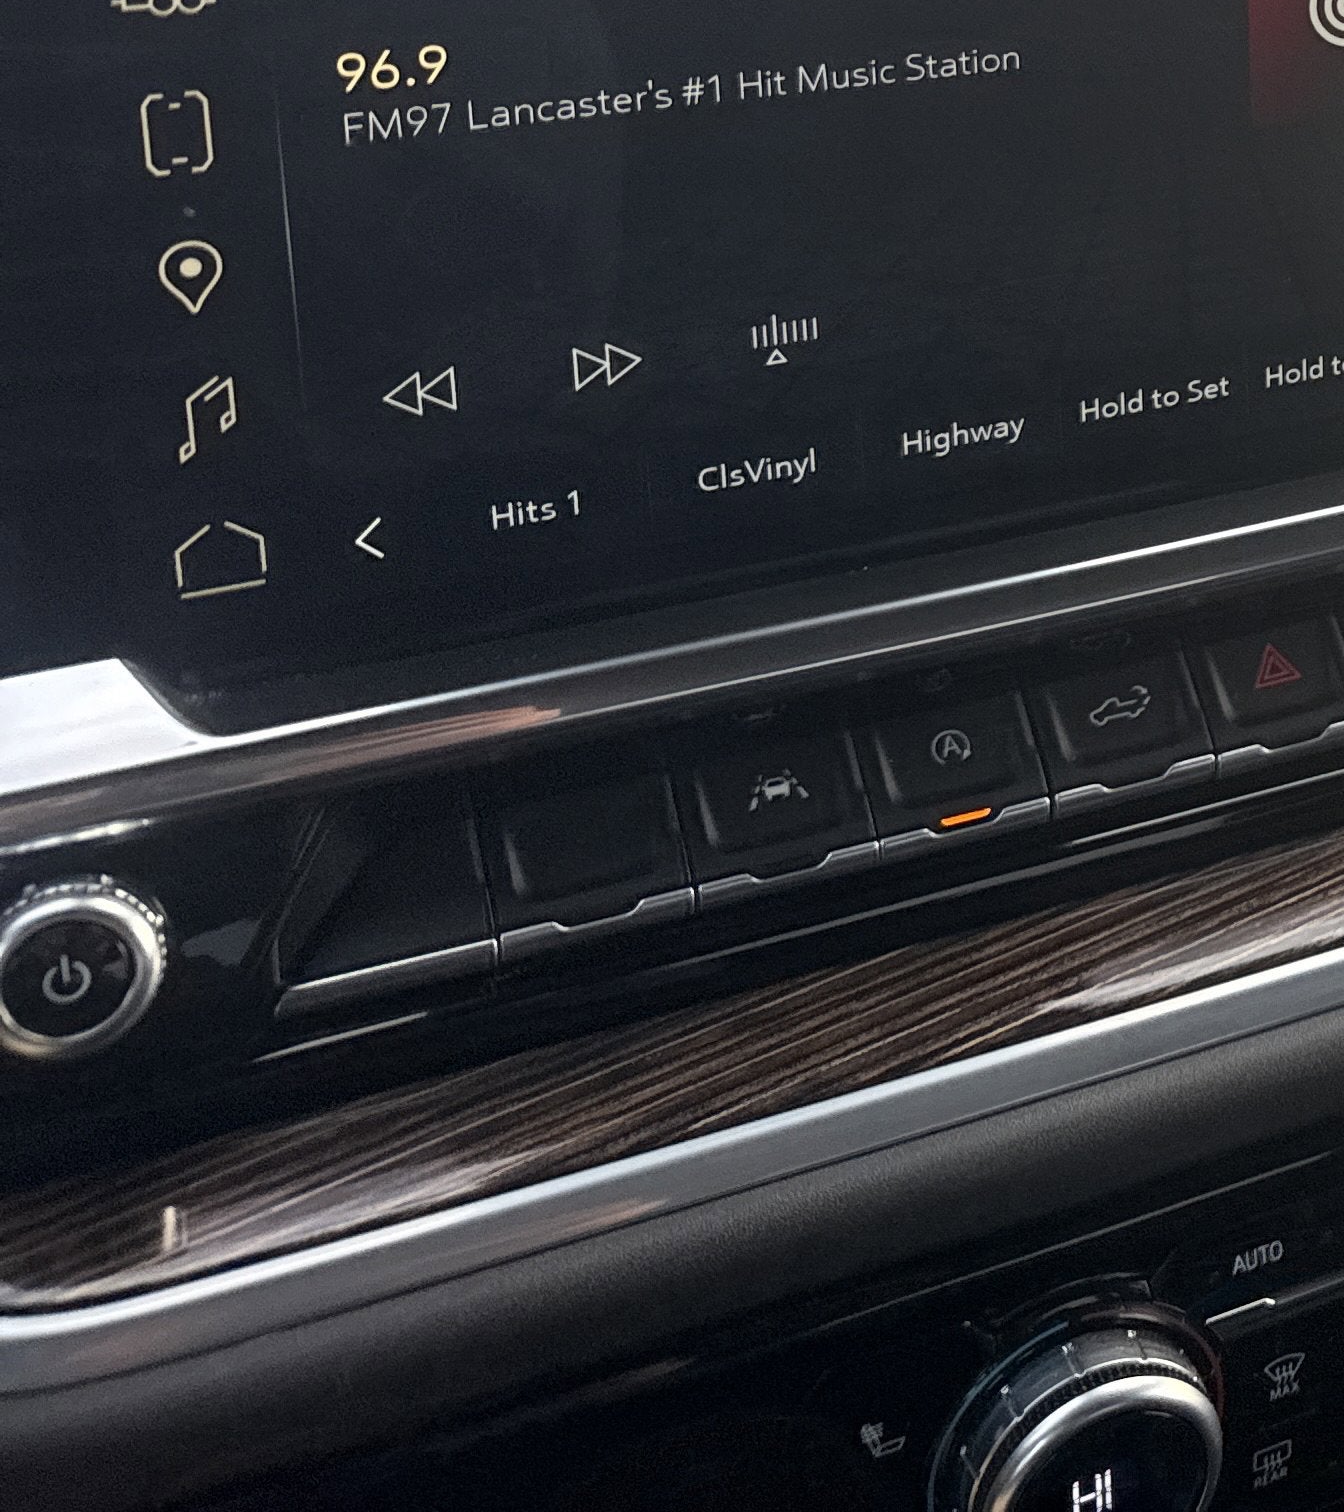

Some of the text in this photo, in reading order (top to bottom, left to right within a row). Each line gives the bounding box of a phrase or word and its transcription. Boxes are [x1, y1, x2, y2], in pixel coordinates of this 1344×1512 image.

[336, 44, 448, 93] 96.9
[343, 48, 1021, 147] FM97 Lancaster's #1 Hit Music Station
[1264, 355, 1324, 388] Hold
[1080, 376, 1230, 423] Hold to Set
[903, 417, 1026, 458] Highway
[697, 447, 818, 492] ClsVinyl
[491, 490, 582, 530] Hits 1
[1232, 1240, 1284, 1277] AUTO
[1269, 1380, 1301, 1402] MAX
[1072, 1468, 1113, 1512] HI
[1253, 1466, 1289, 1489] REAR
